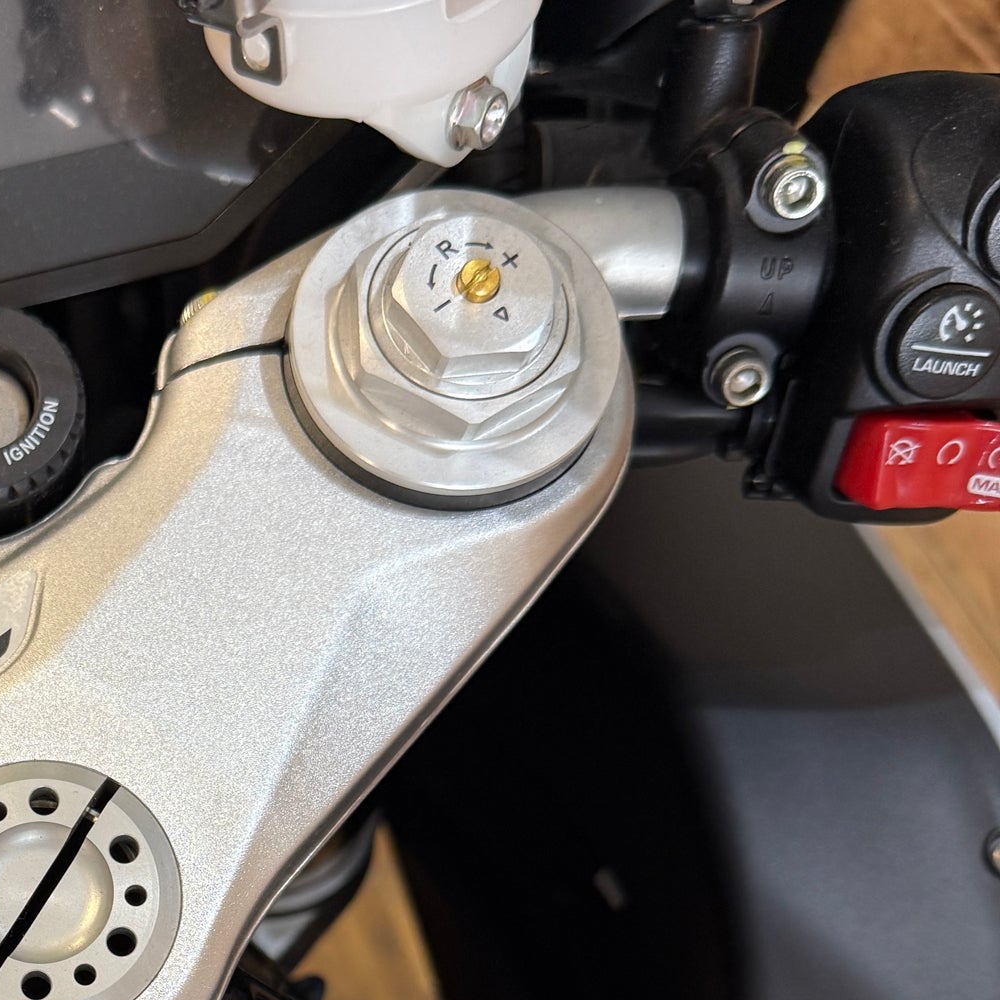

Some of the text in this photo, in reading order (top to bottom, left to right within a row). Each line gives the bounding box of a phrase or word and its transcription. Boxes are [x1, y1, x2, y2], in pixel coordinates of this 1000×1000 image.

[760, 256, 794, 281] UP
[912, 357, 981, 377] LAUNCH
[3, 399, 59, 466] IGNITION
